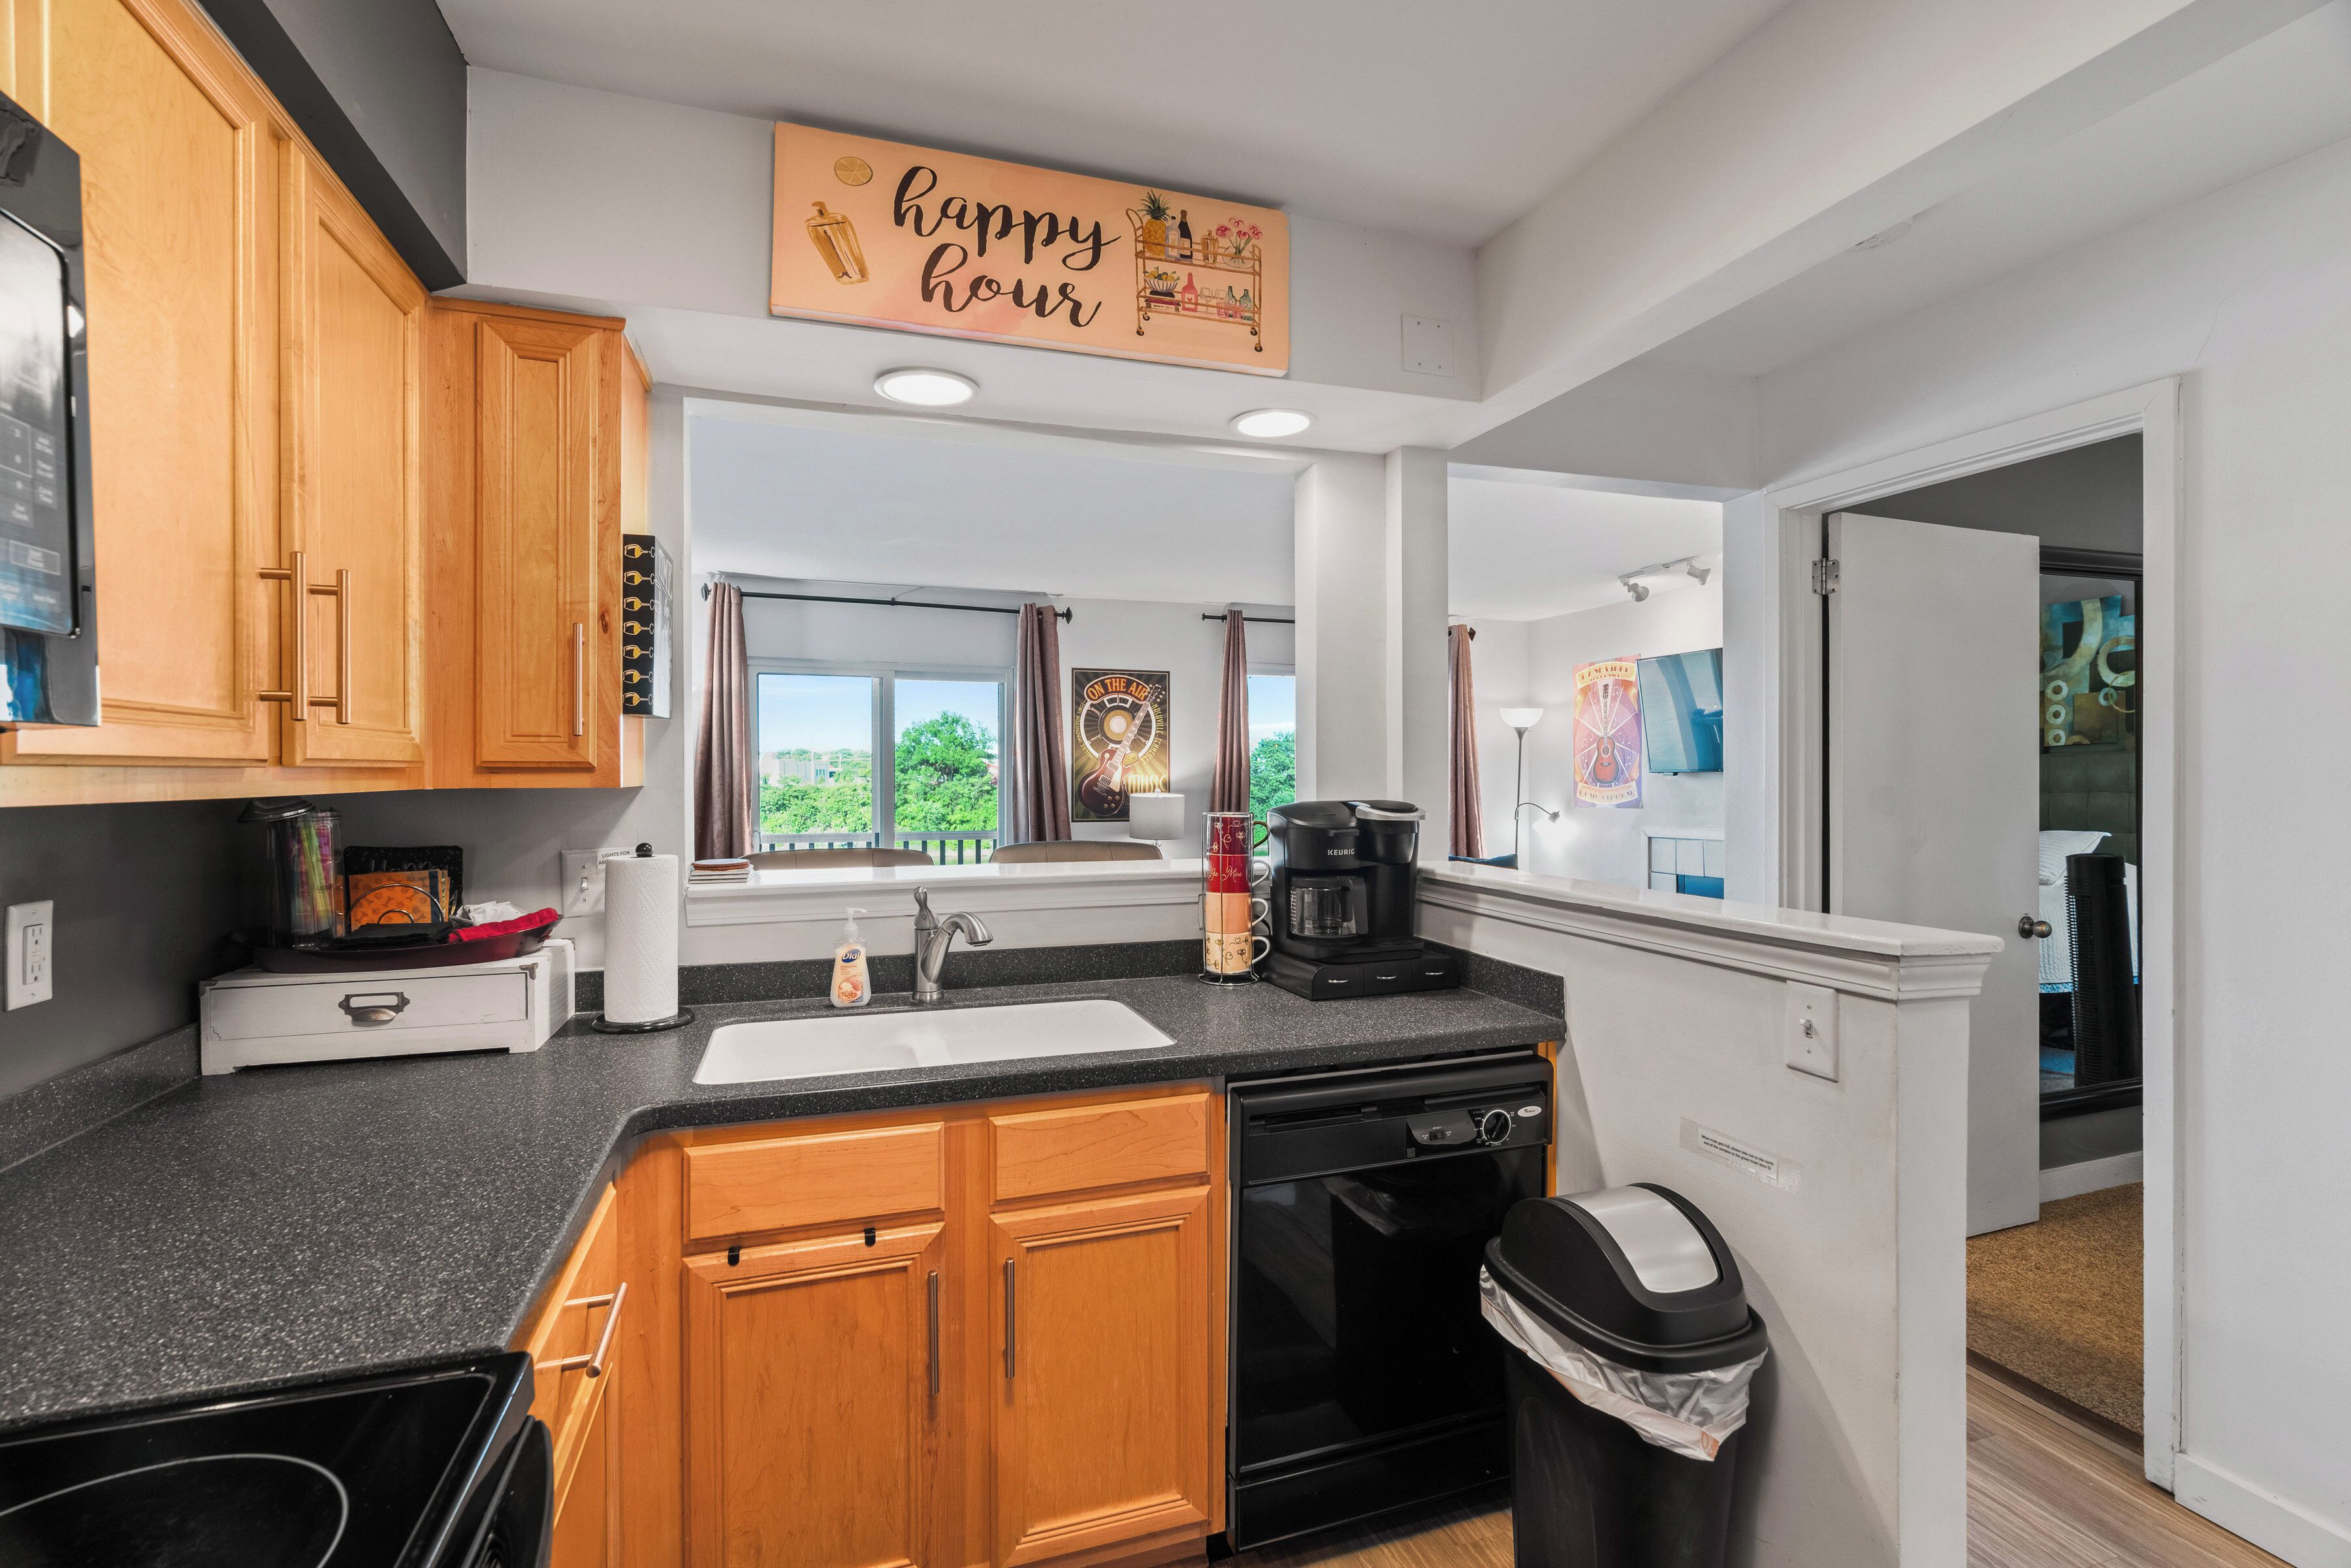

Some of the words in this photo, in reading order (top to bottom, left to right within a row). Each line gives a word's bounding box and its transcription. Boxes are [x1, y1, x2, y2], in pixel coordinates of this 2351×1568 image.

[893, 165, 1122, 271] happy
[921, 242, 1102, 328] hour
[1087, 682, 1105, 699] ON
[1104, 678, 1127, 692] THE
[1128, 682, 1149, 701] AIR
[1151, 703, 1164, 735] NASHVILLE
[1128, 773, 1168, 794] MUSIC
[1222, 865, 1243, 883] Mine
[842, 952, 861, 960] Dial
